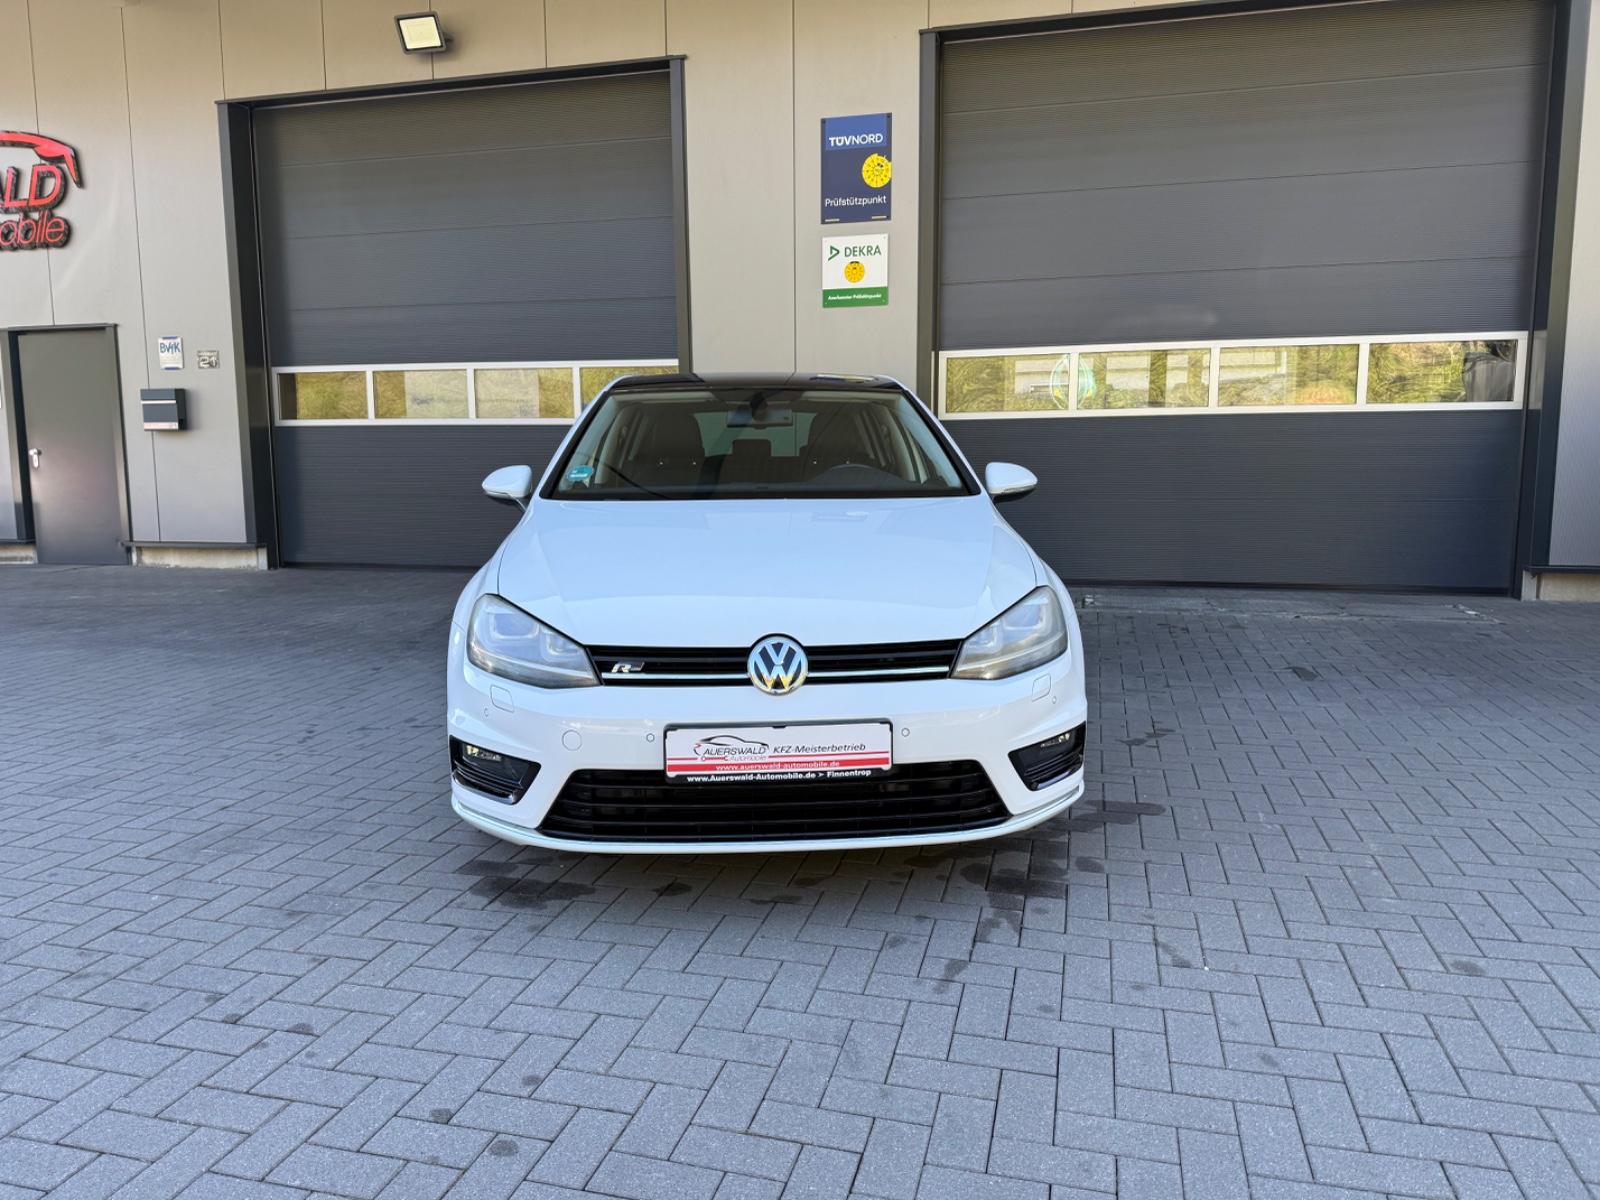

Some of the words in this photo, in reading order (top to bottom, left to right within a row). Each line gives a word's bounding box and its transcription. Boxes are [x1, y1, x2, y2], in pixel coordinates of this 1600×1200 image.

[0, 164, 65, 209] LD
[824, 194, 887, 208] Prüfstützpunkt
[844, 245, 882, 257] DEKRA
[702, 745, 767, 756] AUERSWALD
[716, 761, 840, 771] www.auerswald-automobile.de
[687, 771, 816, 782] www.Auerswald-Automobile.de
[826, 769, 872, 778] Finnentrop
